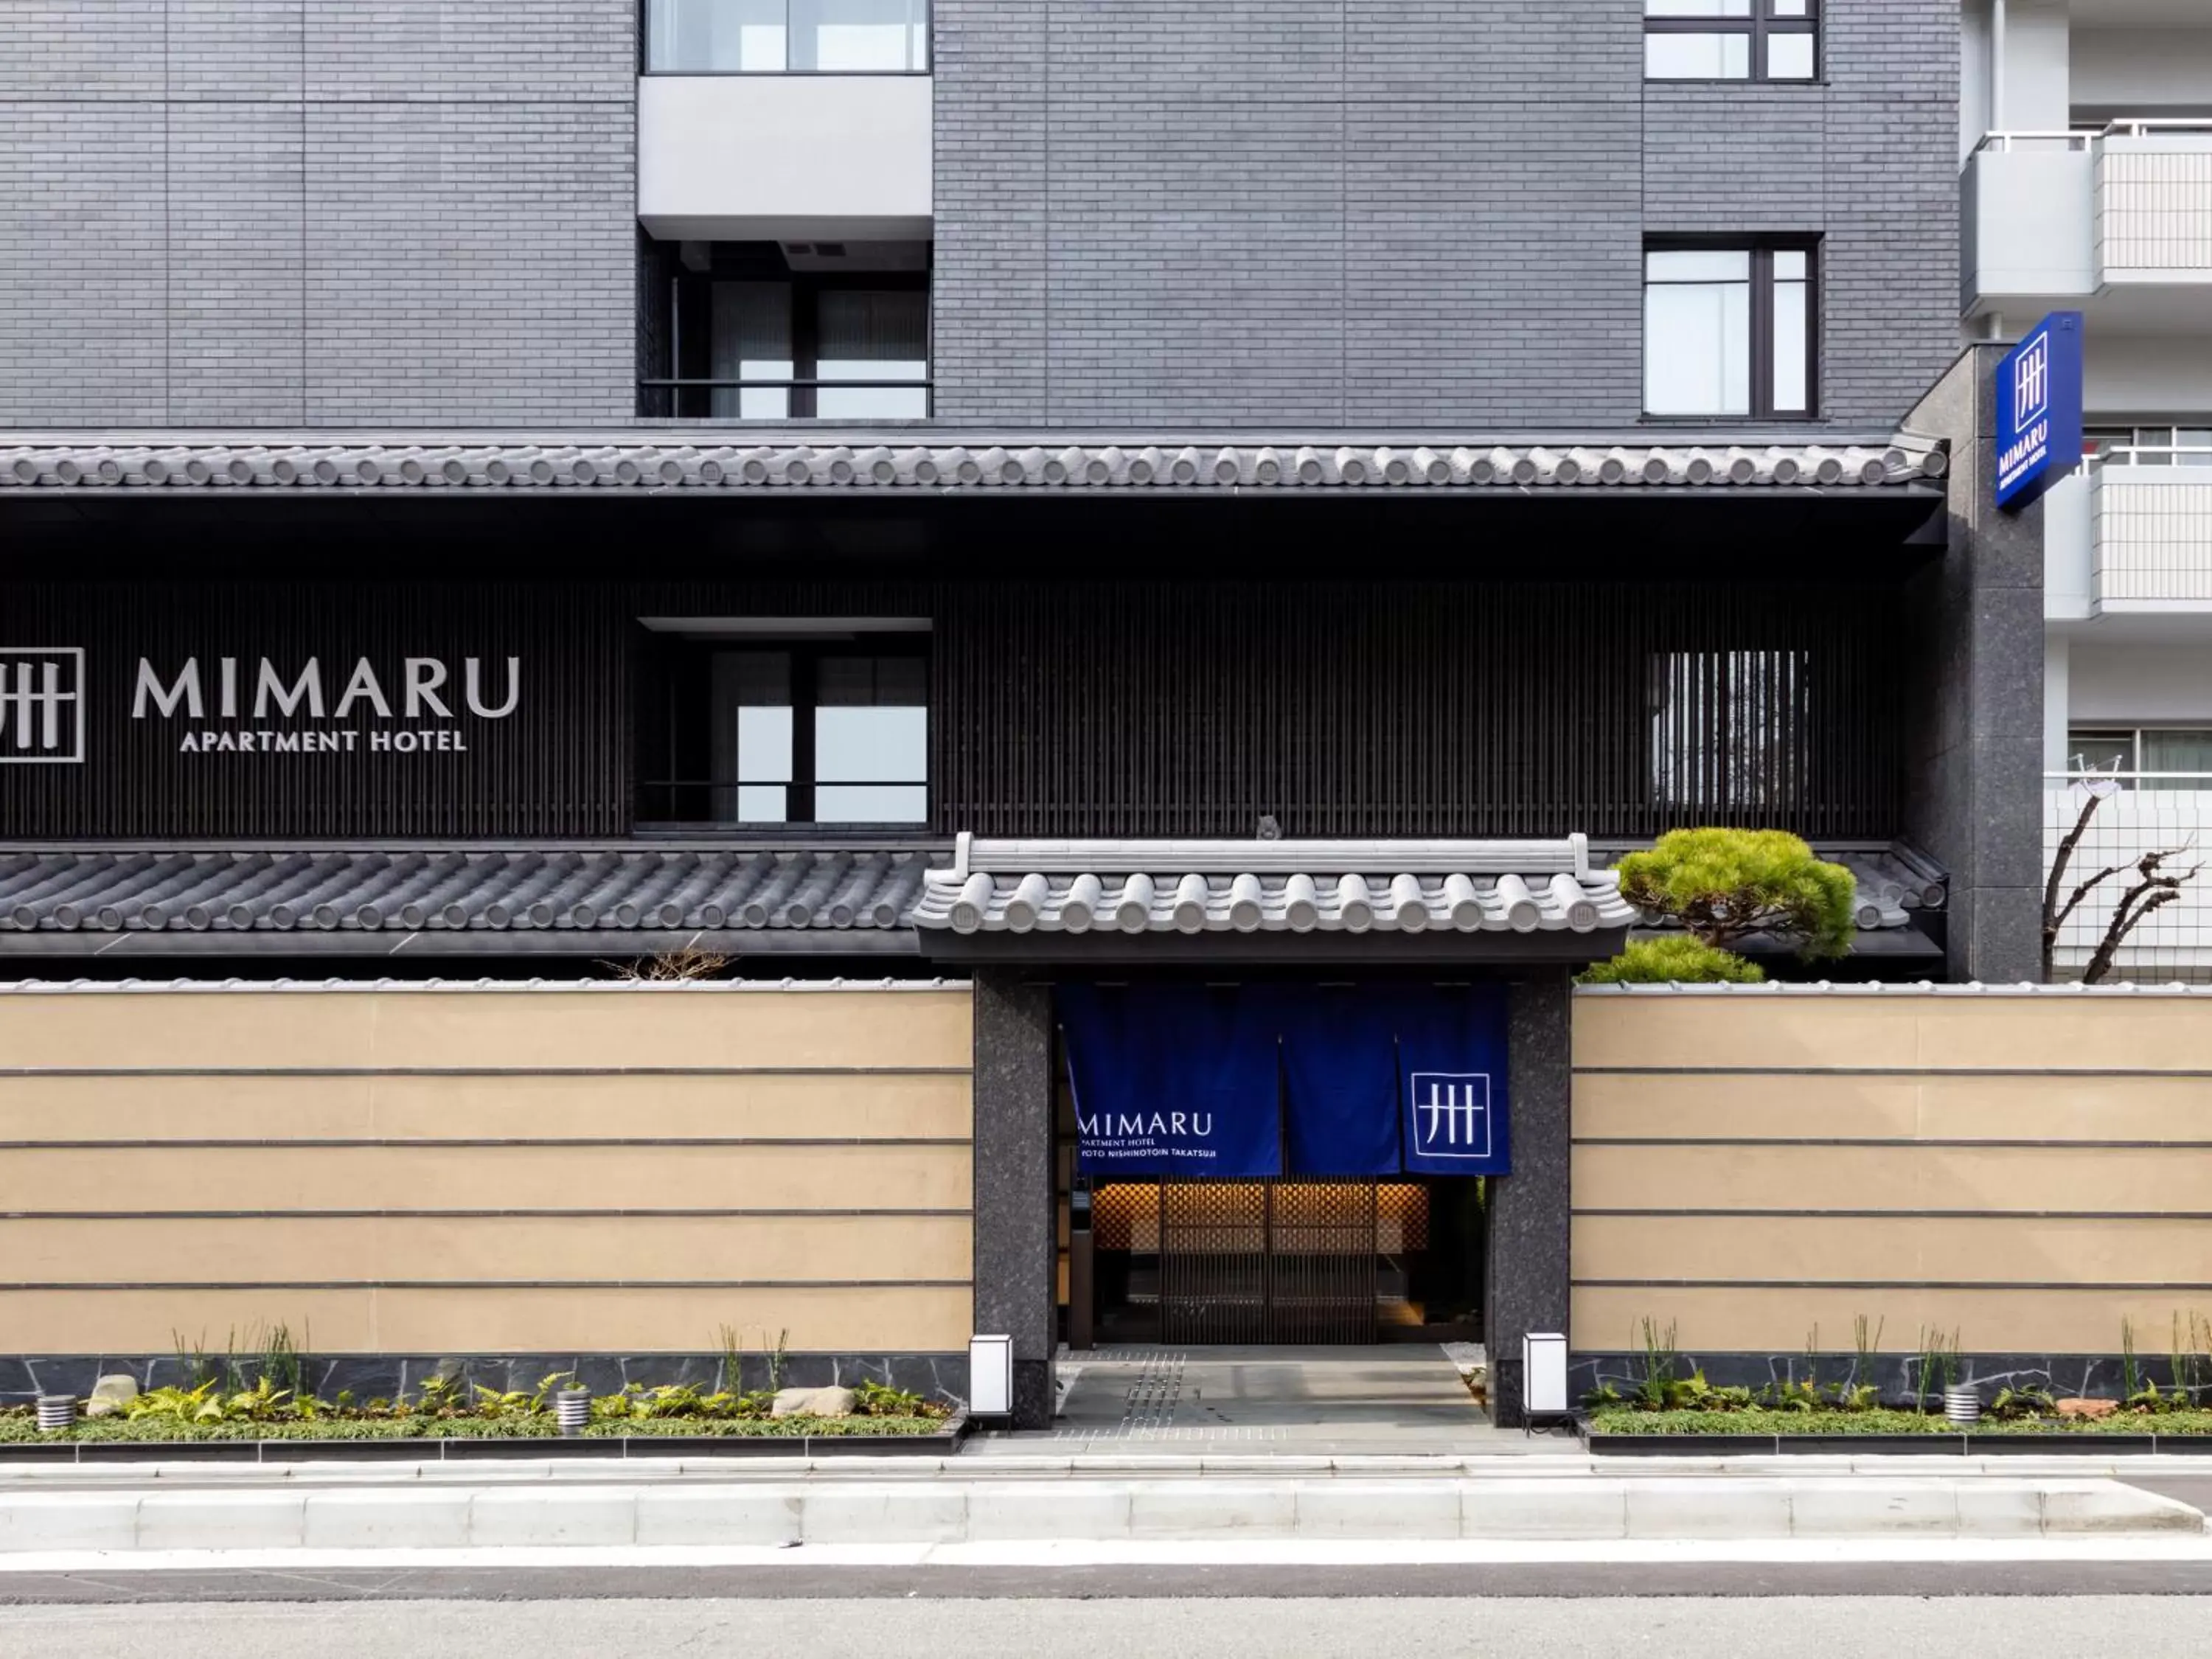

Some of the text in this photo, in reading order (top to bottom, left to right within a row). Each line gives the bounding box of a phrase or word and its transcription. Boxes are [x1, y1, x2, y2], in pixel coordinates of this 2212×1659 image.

[1999, 419, 2048, 477] MIMARU
[131, 656, 520, 718] MIMARU
[179, 730, 468, 752] APARTMENT HOTEL
[1077, 1111, 1211, 1136] MIMARU
[1128, 1138, 1155, 1146] HOTEL
[1171, 1148, 1216, 1158] TAKATSUJI
